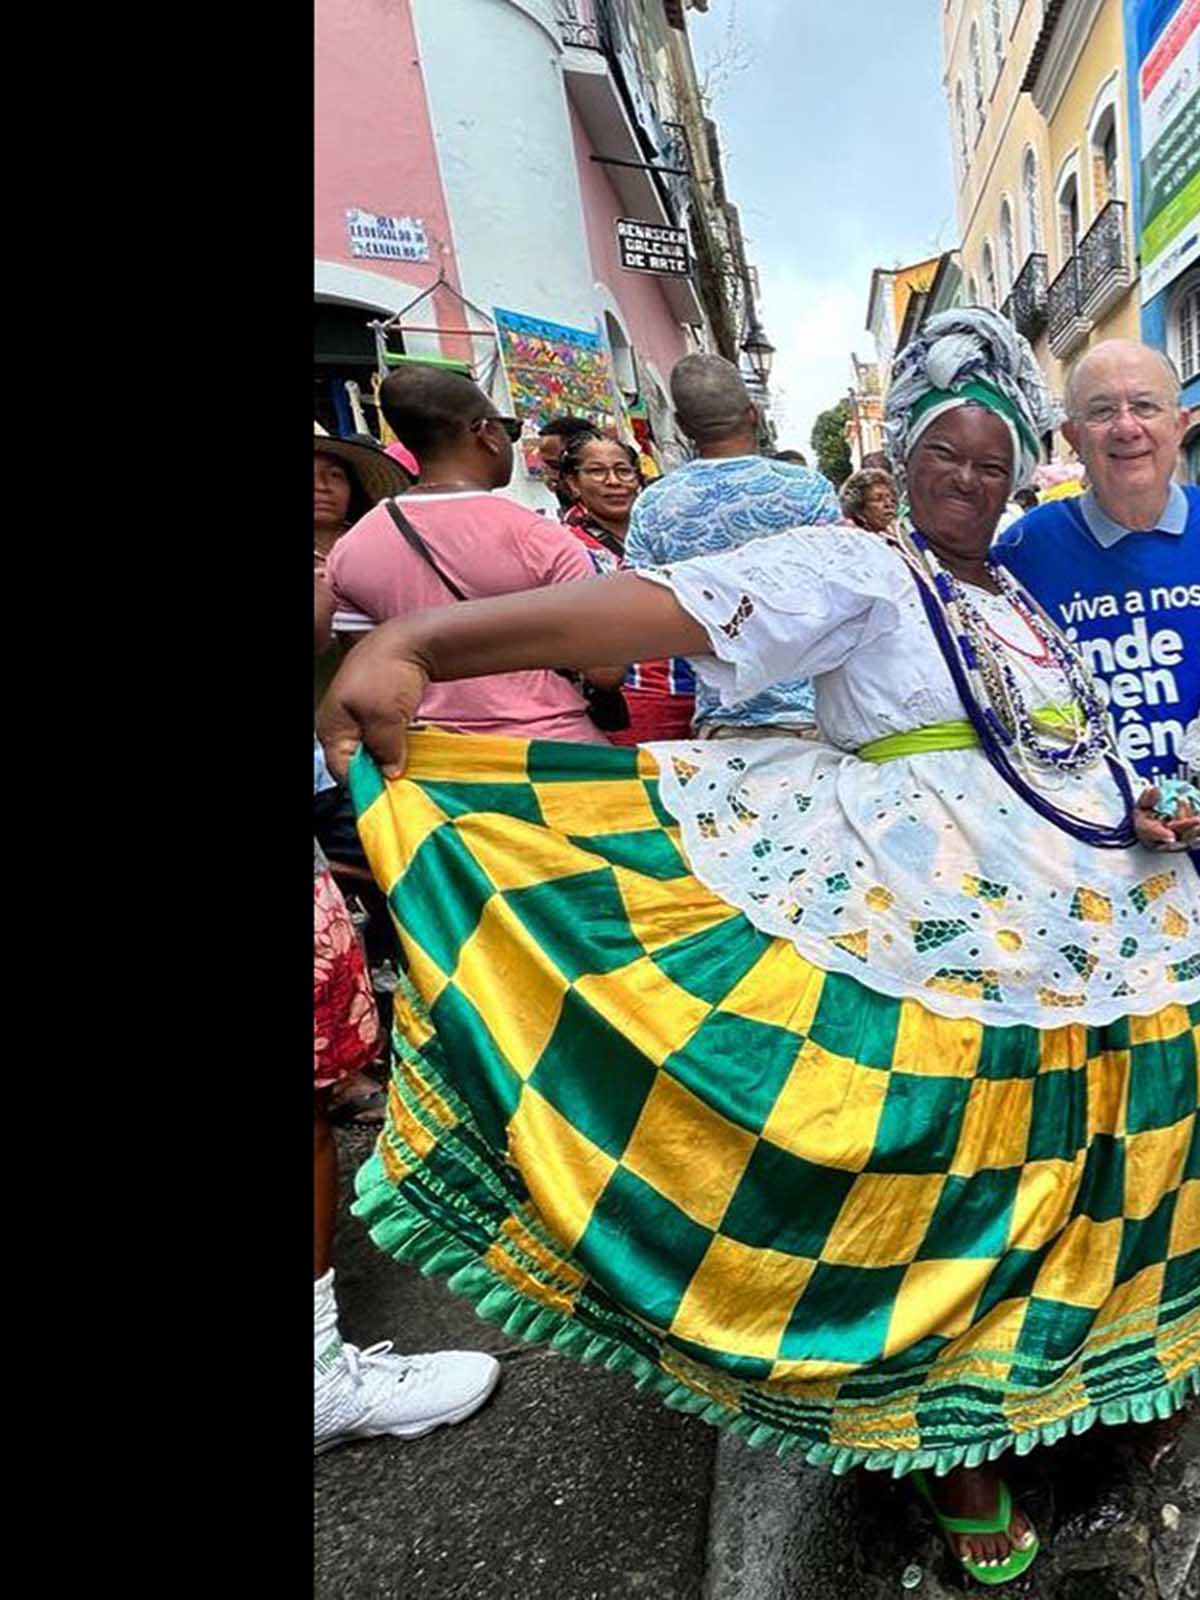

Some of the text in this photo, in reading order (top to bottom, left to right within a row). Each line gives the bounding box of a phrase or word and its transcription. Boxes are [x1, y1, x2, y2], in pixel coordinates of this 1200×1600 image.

[625, 238, 684, 258] GALERIA
[625, 253, 687, 272] DE ARTE
[1059, 590, 1120, 624] viva
[1124, 590, 1146, 614] a
[1065, 616, 1184, 673] inde
[1103, 708, 1185, 761] ên
